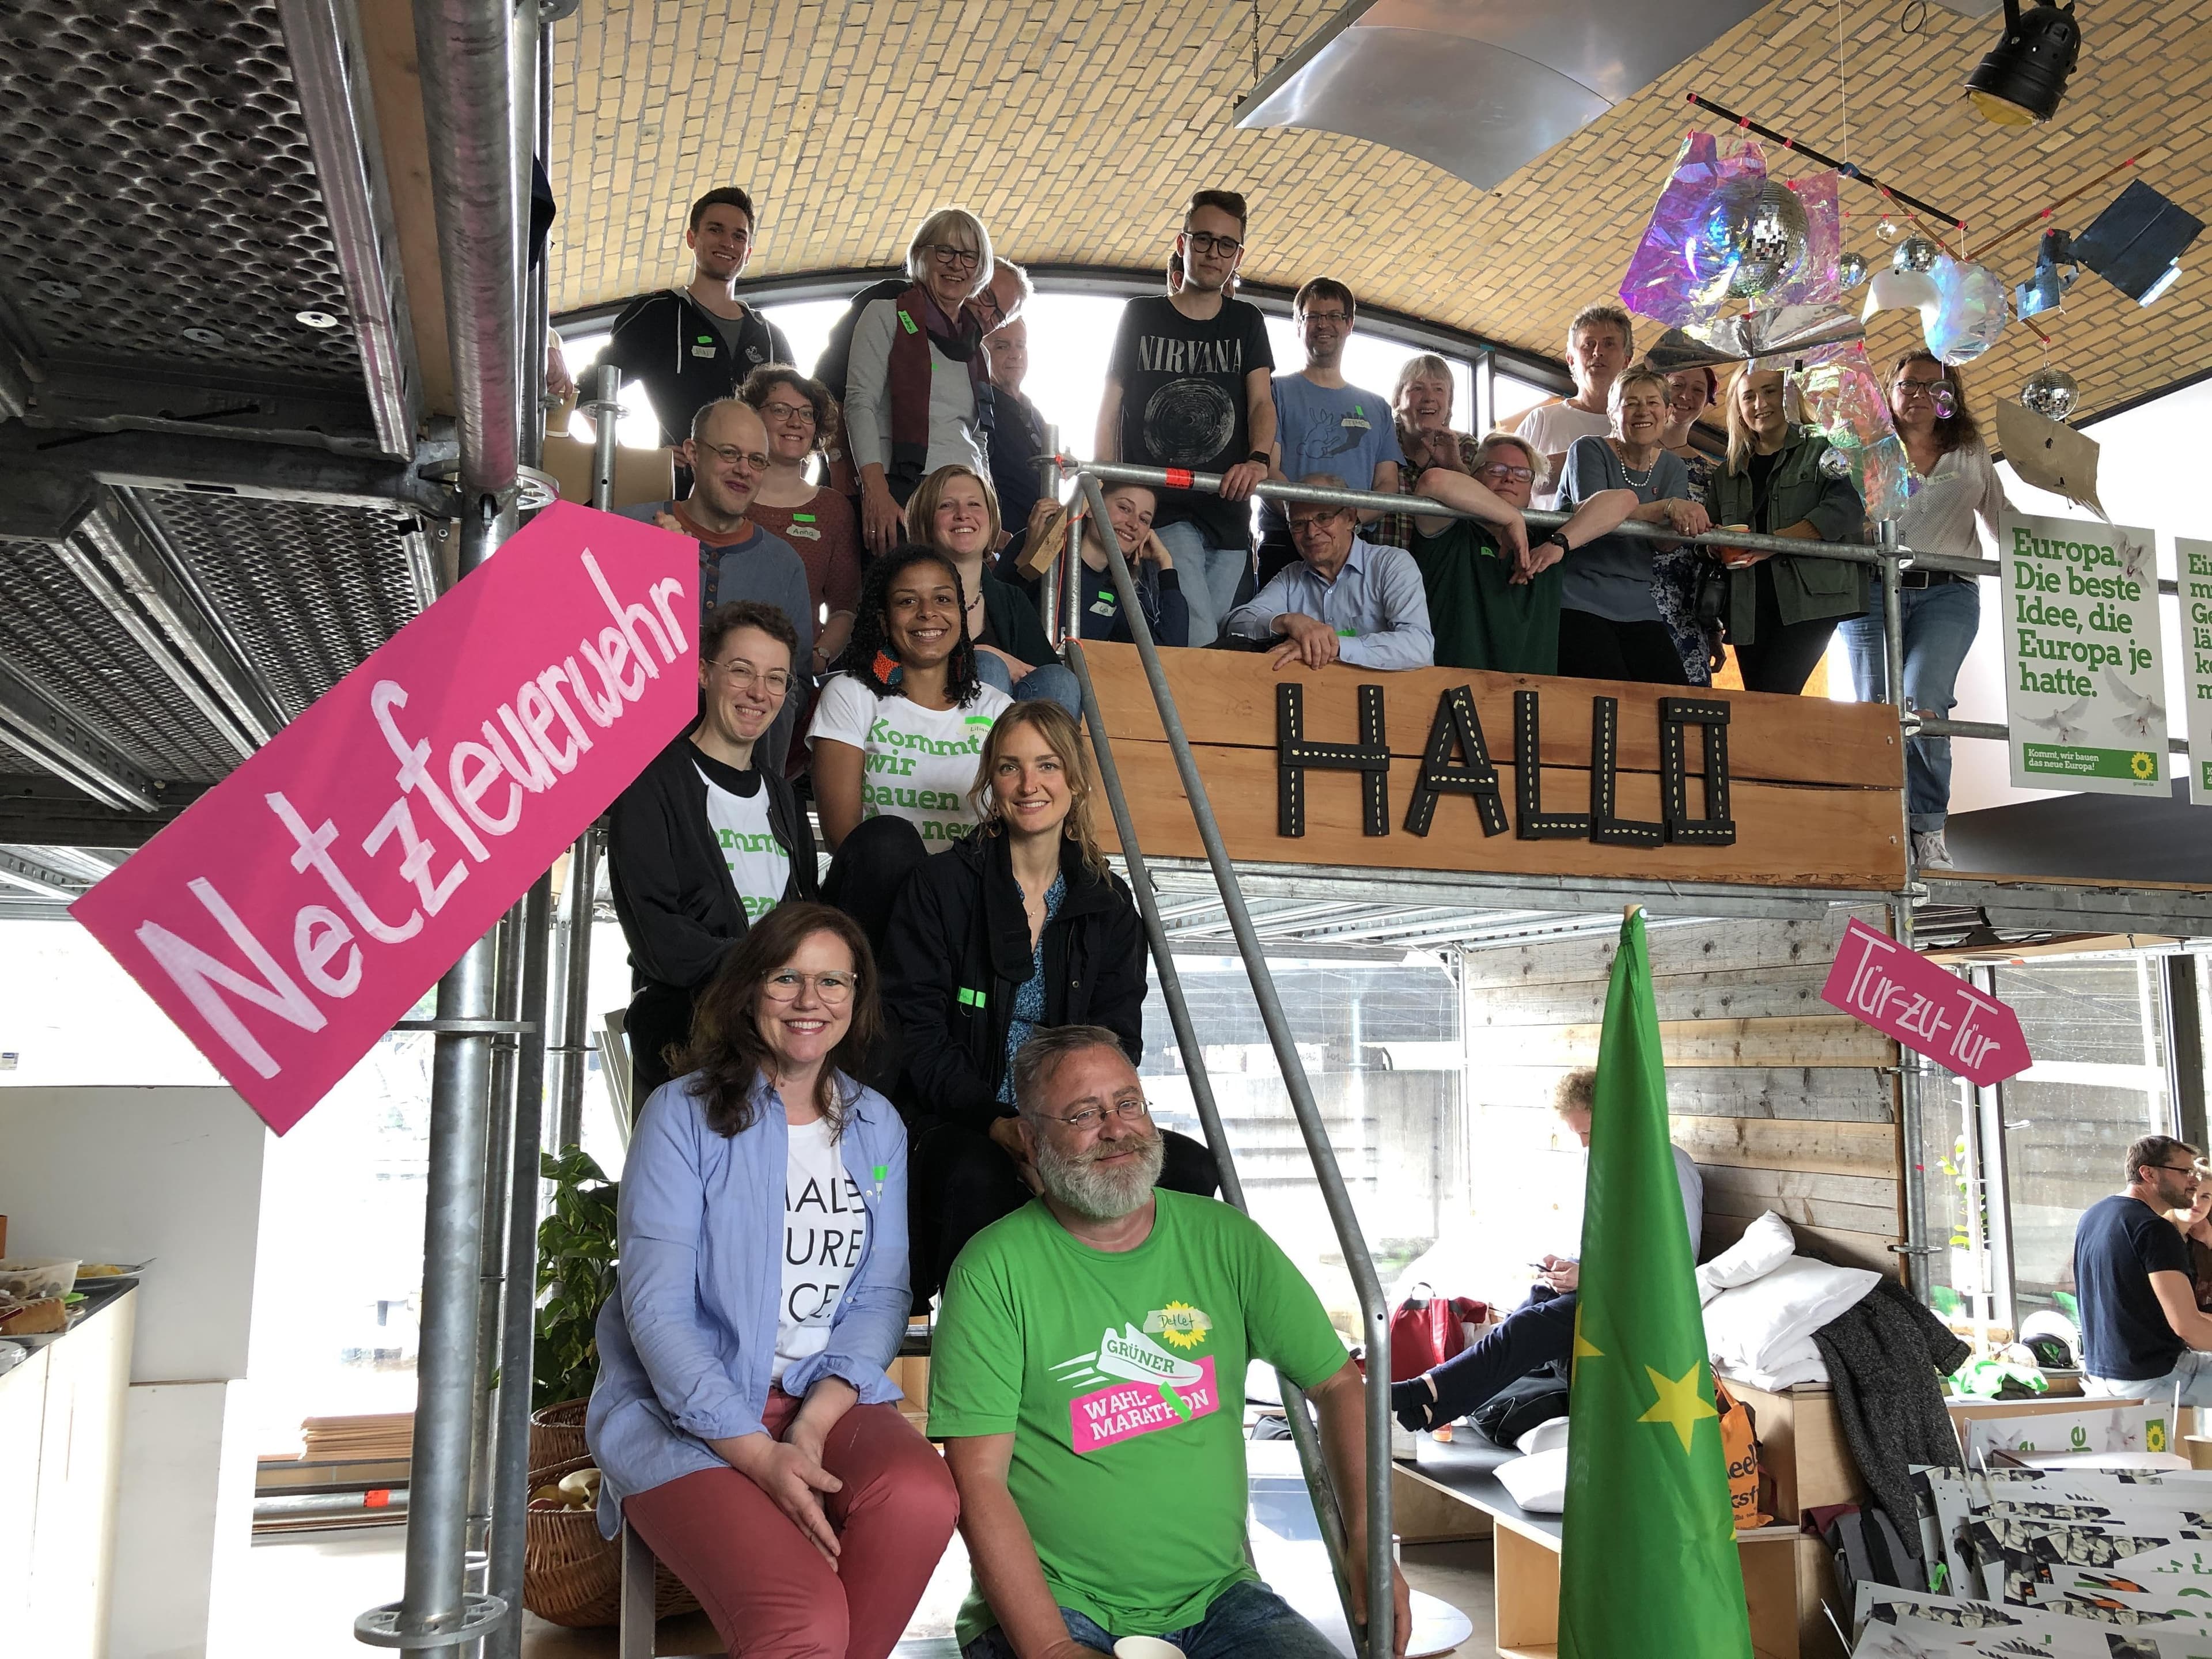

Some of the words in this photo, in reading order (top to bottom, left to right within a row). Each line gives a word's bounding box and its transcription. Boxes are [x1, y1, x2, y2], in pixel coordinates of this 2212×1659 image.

[1137, 335, 1241, 375] NIRVANA
[793, 529, 814, 537] Anna
[2012, 527, 2123, 571] Europa.
[2014, 560, 2061, 593] Die
[2066, 566, 2141, 601] beste
[2016, 594, 2083, 634] Idee,
[2089, 602, 2133, 634] die
[2017, 628, 2122, 672] Europa
[2128, 639, 2153, 675] je
[2018, 661, 2097, 697] hatte.
[866, 749, 916, 776] wir
[1277, 682, 1736, 847] HALLO
[2028, 748, 2059, 760] Kommt,
[2060, 751, 2074, 760] wir
[2075, 752, 2099, 762] bauen
[2029, 758, 2043, 766] das
[2065, 760, 2095, 772] Europa!
[862, 774, 960, 811] bauen
[135, 546, 685, 1079] Netzfeuerwehr
[1846, 927, 2001, 1069] Tür-zu-Tür
[1107, 1339, 1175, 1373] GRÜNER
[1082, 1389, 1153, 1420] WAHL-
